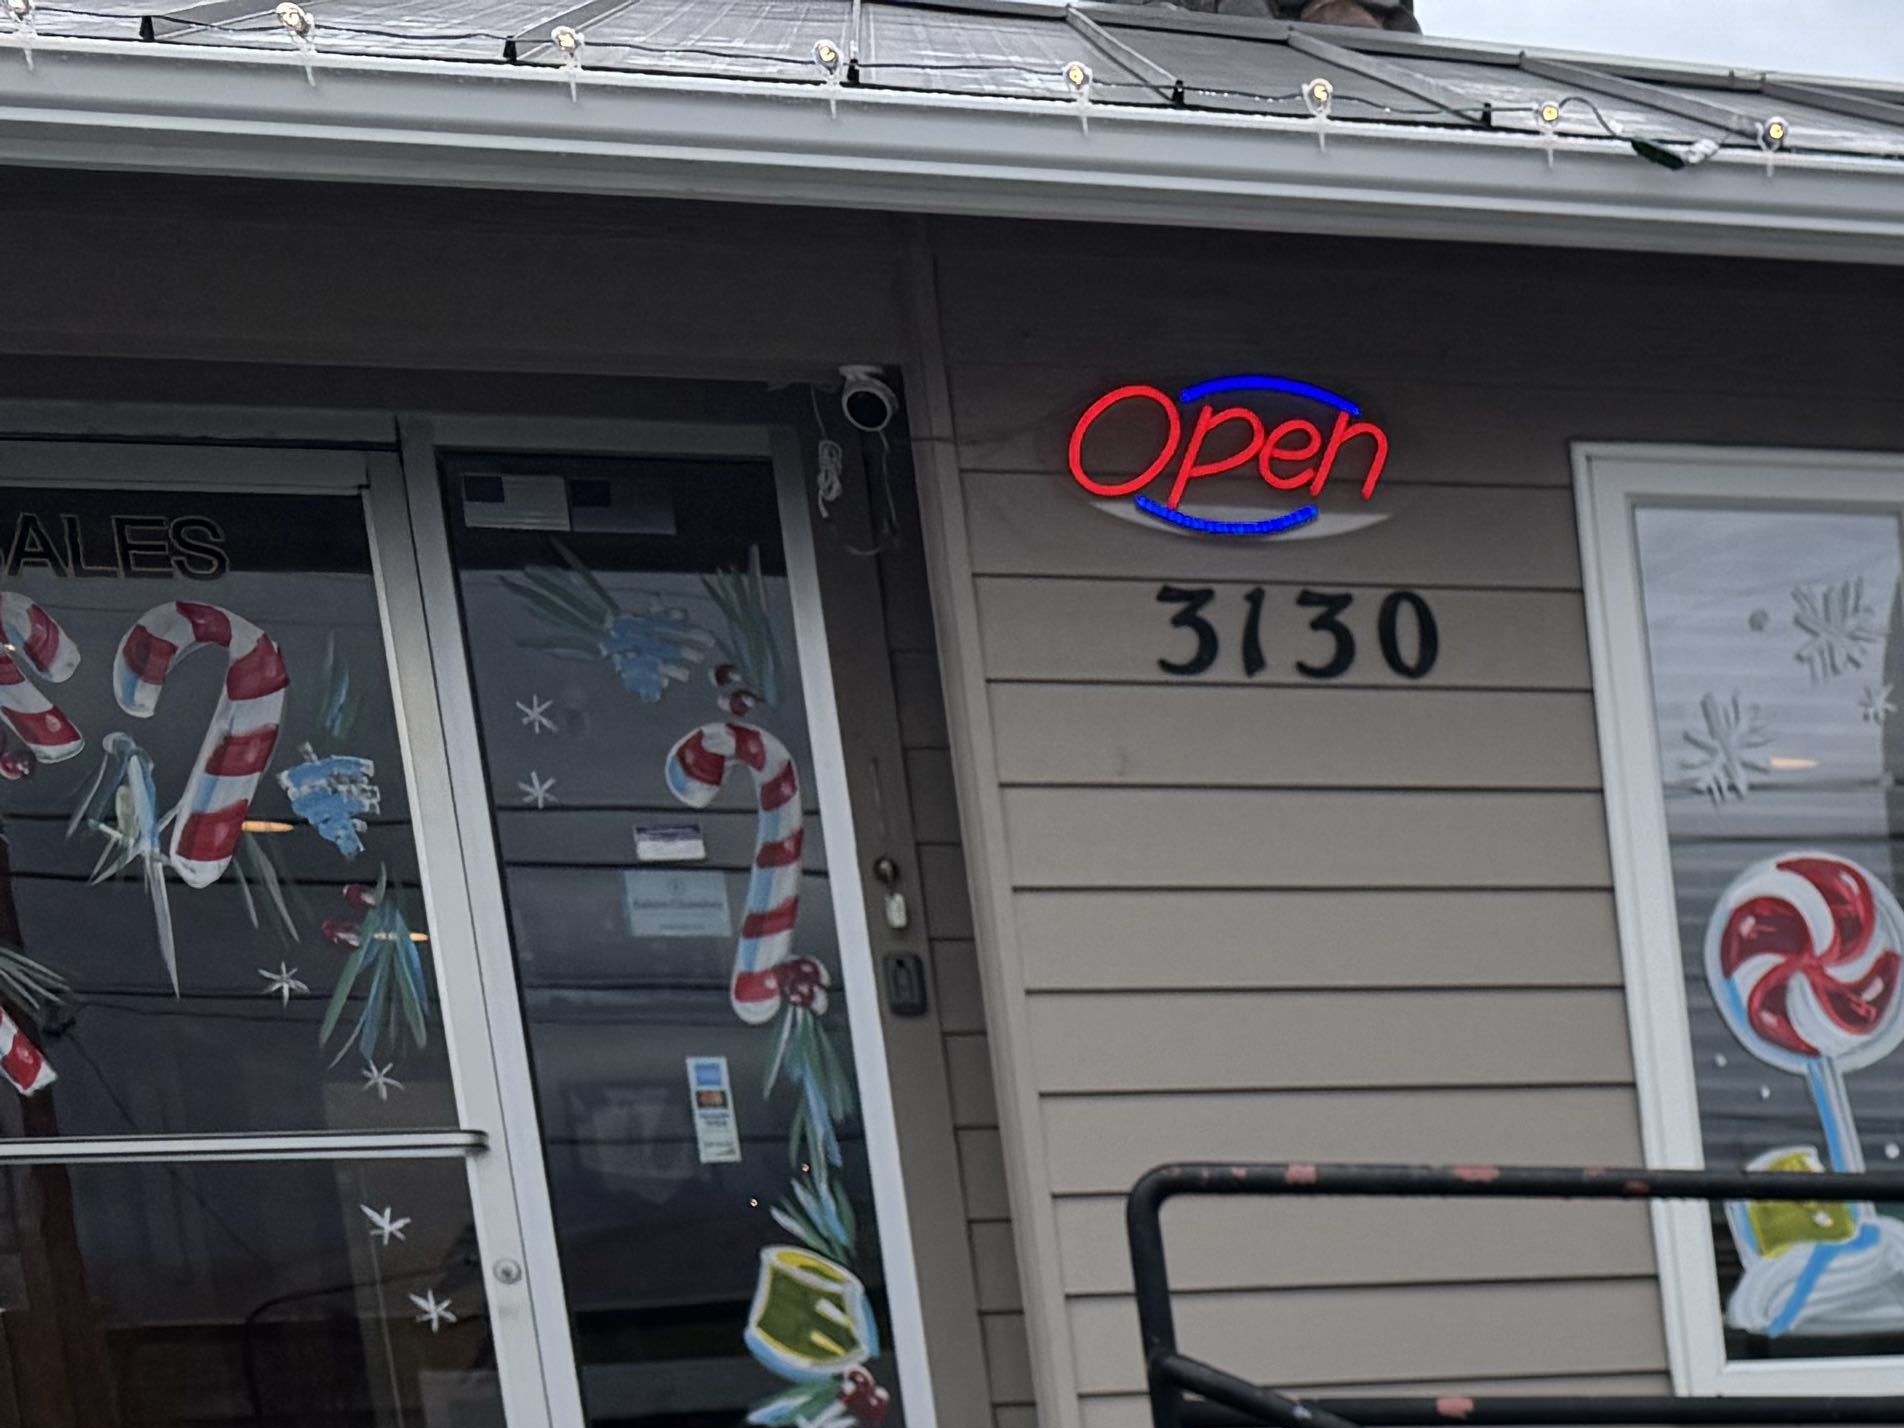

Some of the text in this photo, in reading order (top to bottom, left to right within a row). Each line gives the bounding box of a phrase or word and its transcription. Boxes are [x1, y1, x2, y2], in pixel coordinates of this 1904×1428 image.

[1067, 384, 1389, 510] Open
[0, 512, 229, 582] ALES
[1156, 584, 1440, 679] 3130
